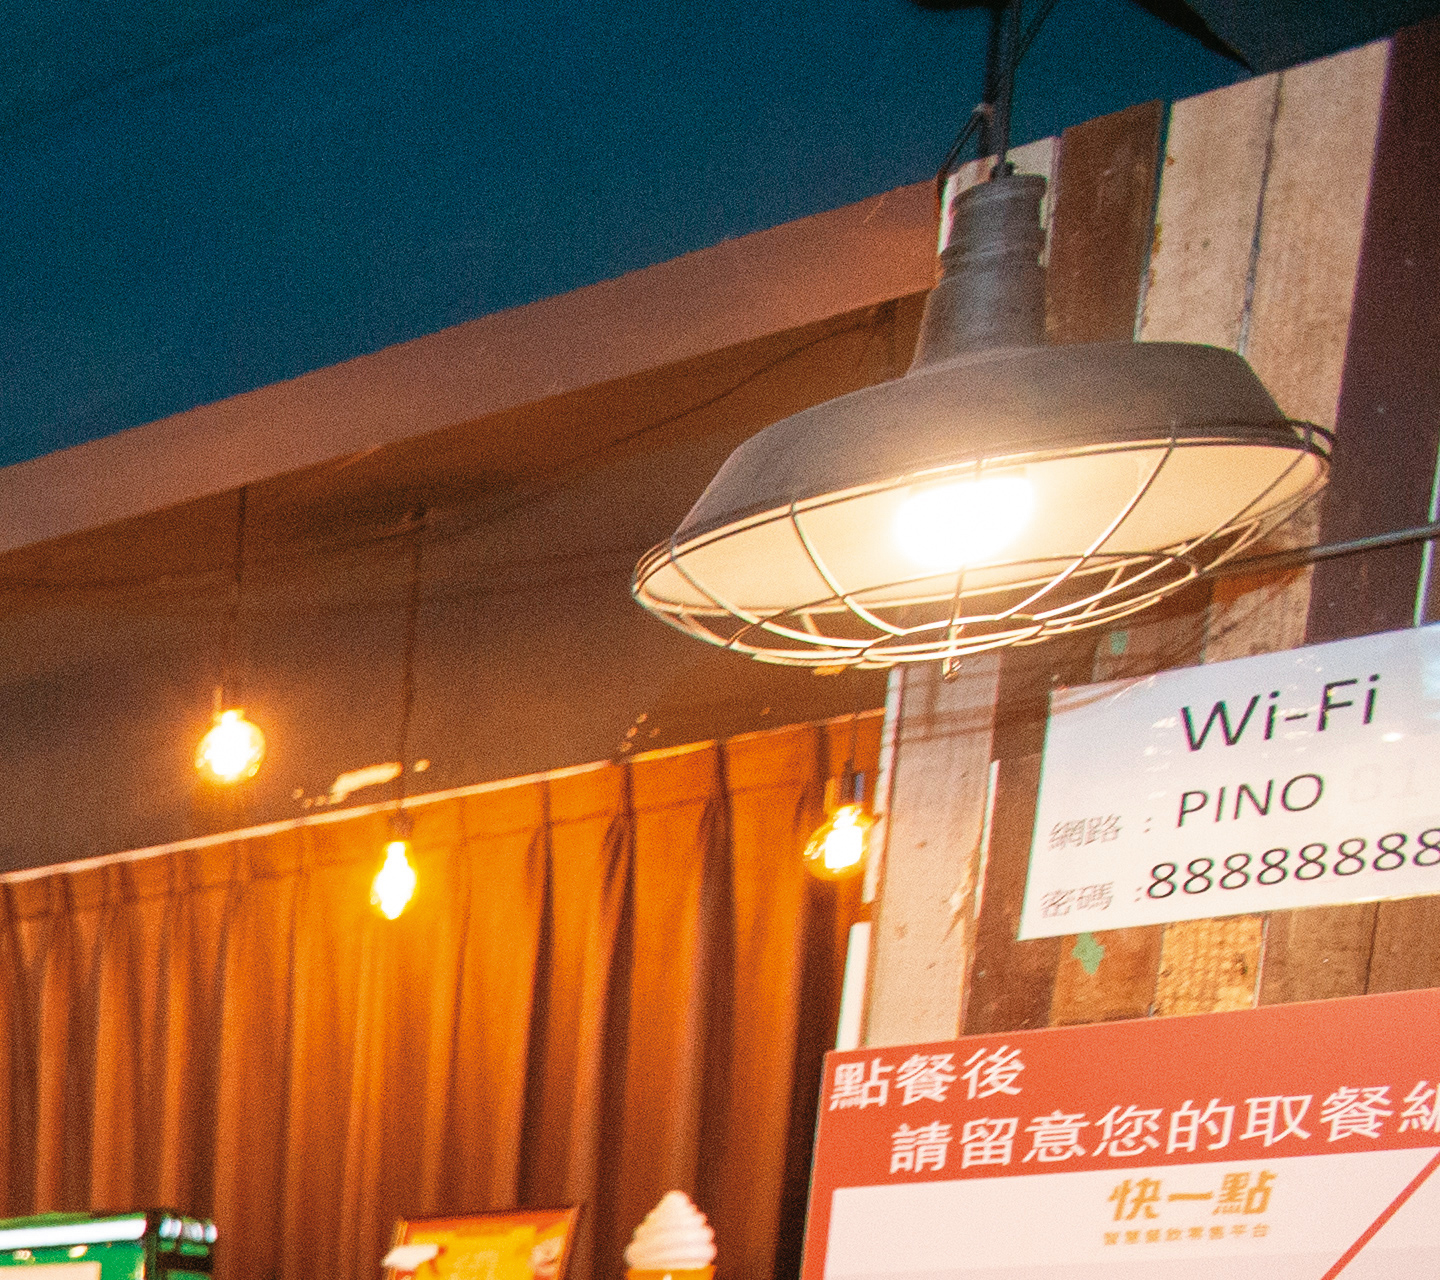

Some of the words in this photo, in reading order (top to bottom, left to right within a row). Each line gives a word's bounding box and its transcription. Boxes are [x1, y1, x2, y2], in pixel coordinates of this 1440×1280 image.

[1180, 673, 1380, 752] Wi-Fi
[1176, 773, 1325, 829] PINO
[1147, 829, 1440, 899] 88888888
[828, 1044, 1026, 1113] 點餐後
[1104, 1169, 1278, 1222] 快一點
